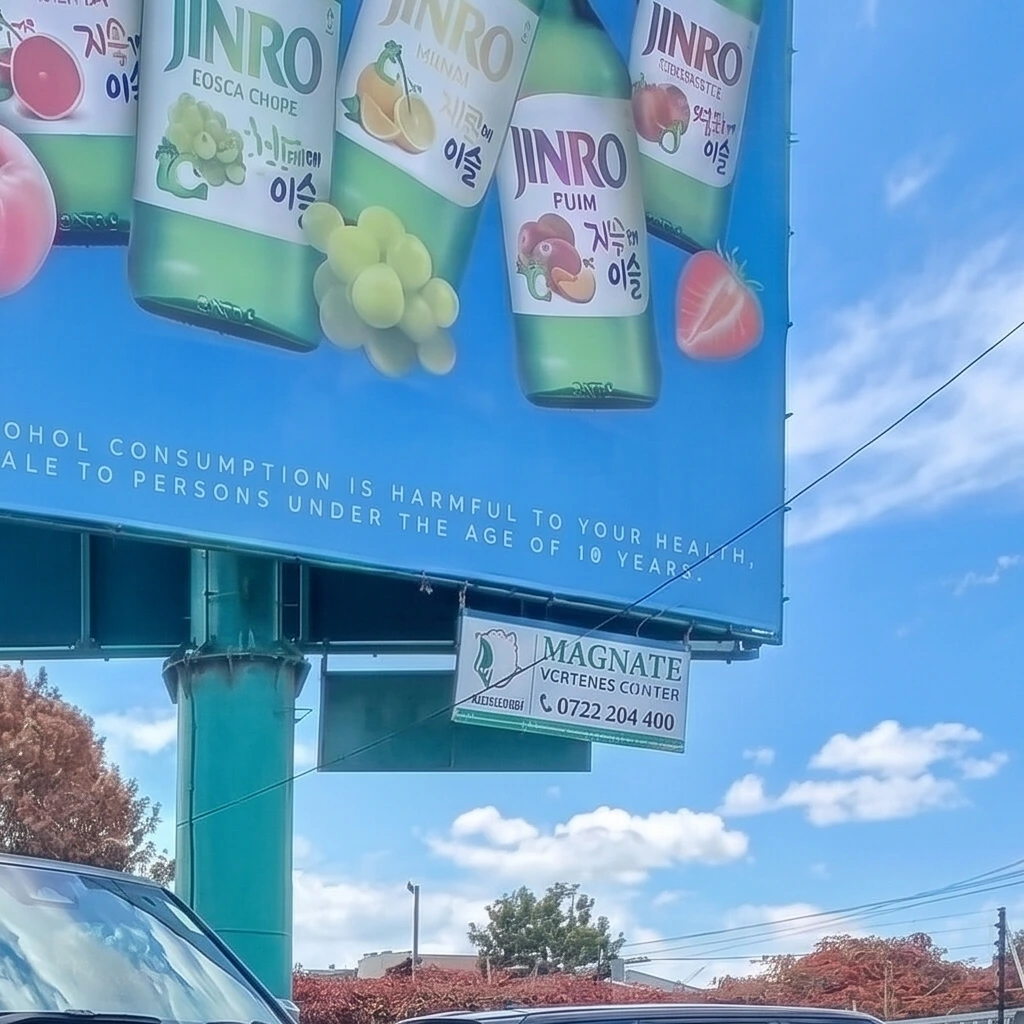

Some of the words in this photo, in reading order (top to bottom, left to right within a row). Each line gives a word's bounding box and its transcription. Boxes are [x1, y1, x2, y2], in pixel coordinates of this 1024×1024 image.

[163, 0, 323, 94] JINRO
[641, 1, 743, 86] JINRO
[444, 137, 482, 188] 이슬
[511, 126, 627, 200] JINRO
[704, 138, 730, 175] 이슬
[608, 252, 642, 300] 이슬
[78, 462, 113, 484] TO
[133, 470, 269, 508] PERSONS
[289, 496, 381, 526] UNDER
[399, 513, 447, 537] THE
[465, 524, 513, 547] AGE
[530, 537, 560, 556] OF
[617, 550, 702, 582] YEARS.
[110, 438, 329, 490] CONSUMPTION
[350, 477, 372, 497] IS
[392, 484, 517, 522] HARMFUL
[532, 509, 563, 530] TO
[578, 517, 641, 544] YOUR
[543, 636, 682, 681] MAGNATE
[557, 697, 601, 720] 0722
[605, 705, 637, 726] 204
[642, 711, 675, 731] 400
